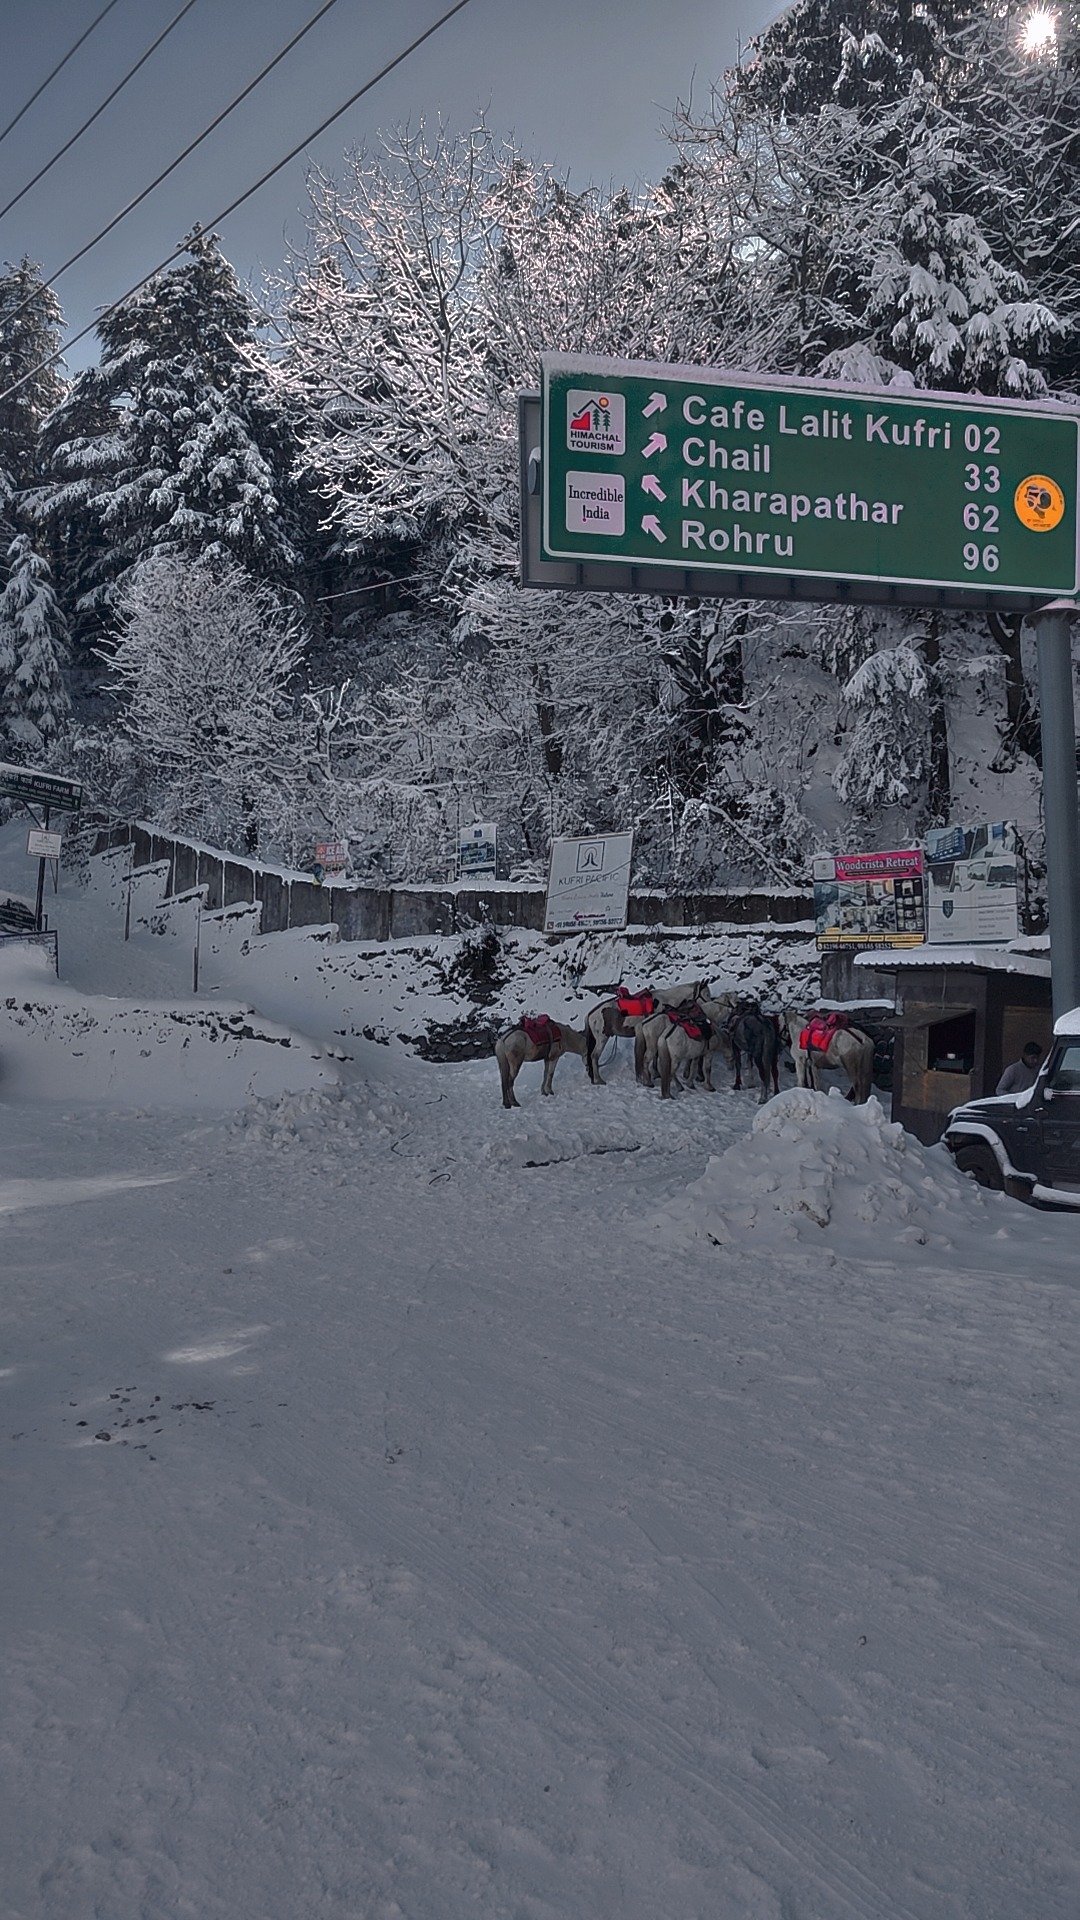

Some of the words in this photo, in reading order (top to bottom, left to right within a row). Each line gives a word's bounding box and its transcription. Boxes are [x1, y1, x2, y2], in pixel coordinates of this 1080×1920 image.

[570, 430, 621, 443] HIMACHAL
[682, 395, 765, 431] Cafe
[779, 405, 853, 440] Lalit
[866, 413, 951, 449] Kufri
[964, 424, 1001, 454] 02
[570, 440, 615, 452] TOURISM
[682, 437, 770, 473] Chail
[964, 463, 1001, 493] 33
[568, 484, 624, 503] Incredible
[681, 478, 904, 525] Kharapathar
[963, 502, 1000, 533] 62
[681, 520, 794, 557] Rohru
[962, 542, 1000, 572] 96
[33, 781, 52, 791] KUFRI
[53, 785, 70, 795] FARM
[836, 859, 885, 871] Woodcrista
[886, 856, 920, 868] Retreat
[558, 875, 584, 886] KUFRI
